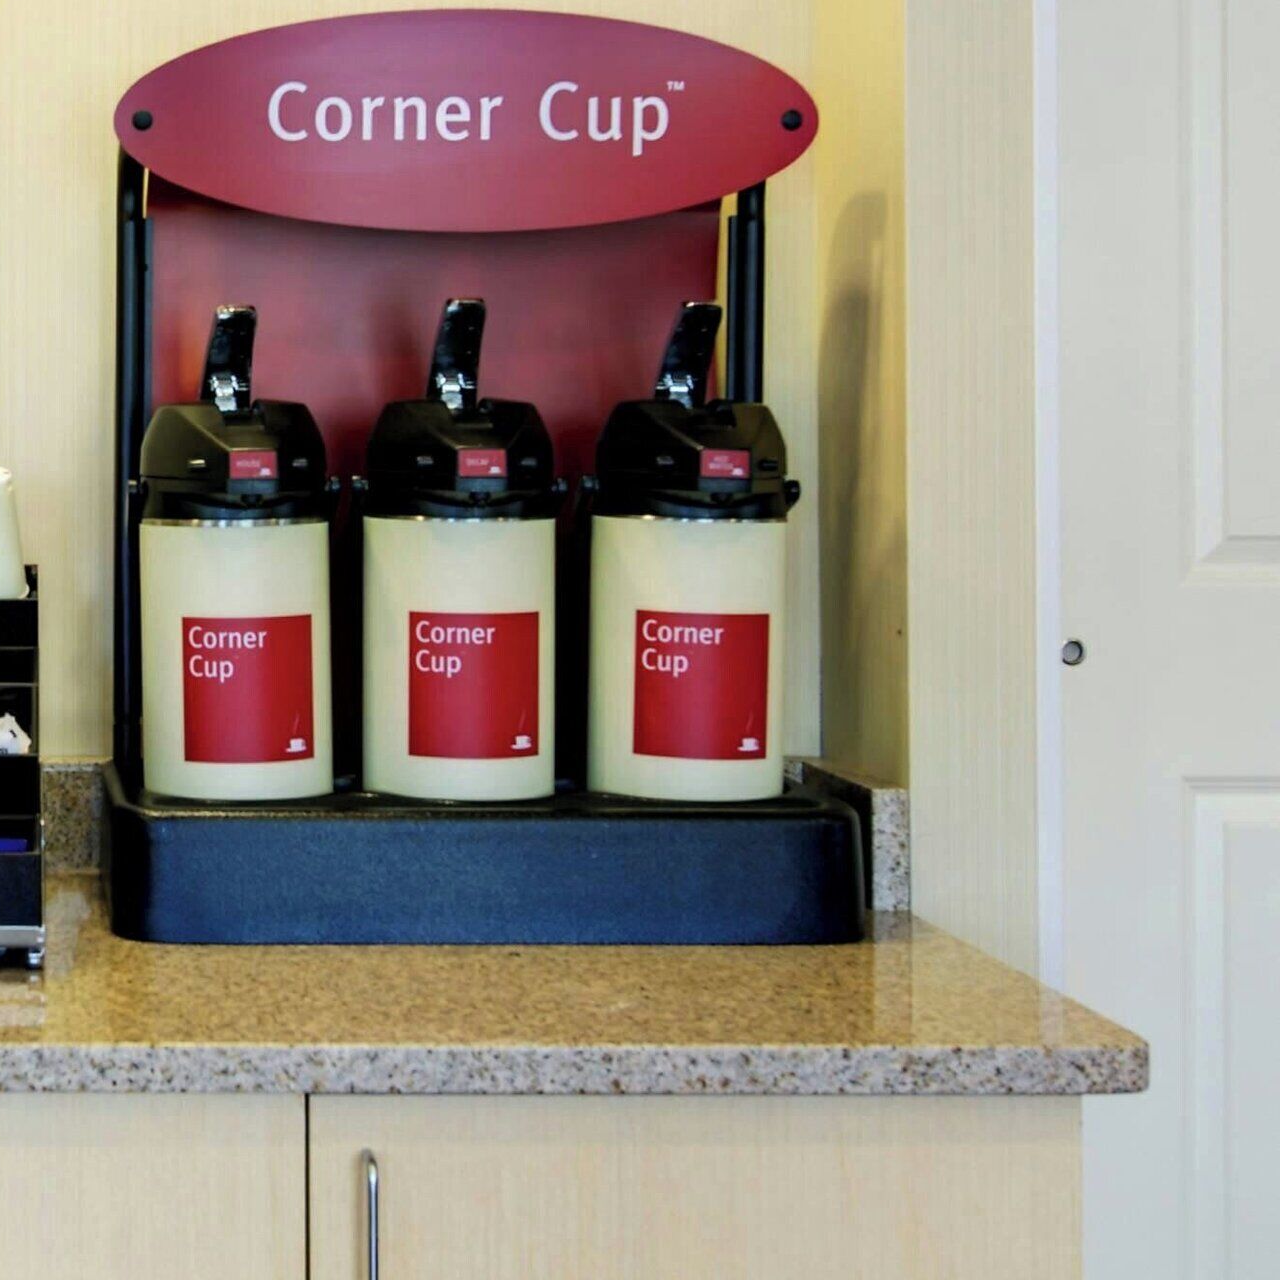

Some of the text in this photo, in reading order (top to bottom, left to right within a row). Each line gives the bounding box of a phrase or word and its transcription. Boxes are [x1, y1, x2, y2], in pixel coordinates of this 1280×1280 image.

[267, 81, 503, 142] Corner
[188, 625, 267, 650] Corner
[415, 620, 495, 645] Corner
[642, 619, 724, 645] Corner
[188, 654, 234, 683] Cup
[415, 649, 462, 678] Cup
[642, 647, 689, 678] Cup
